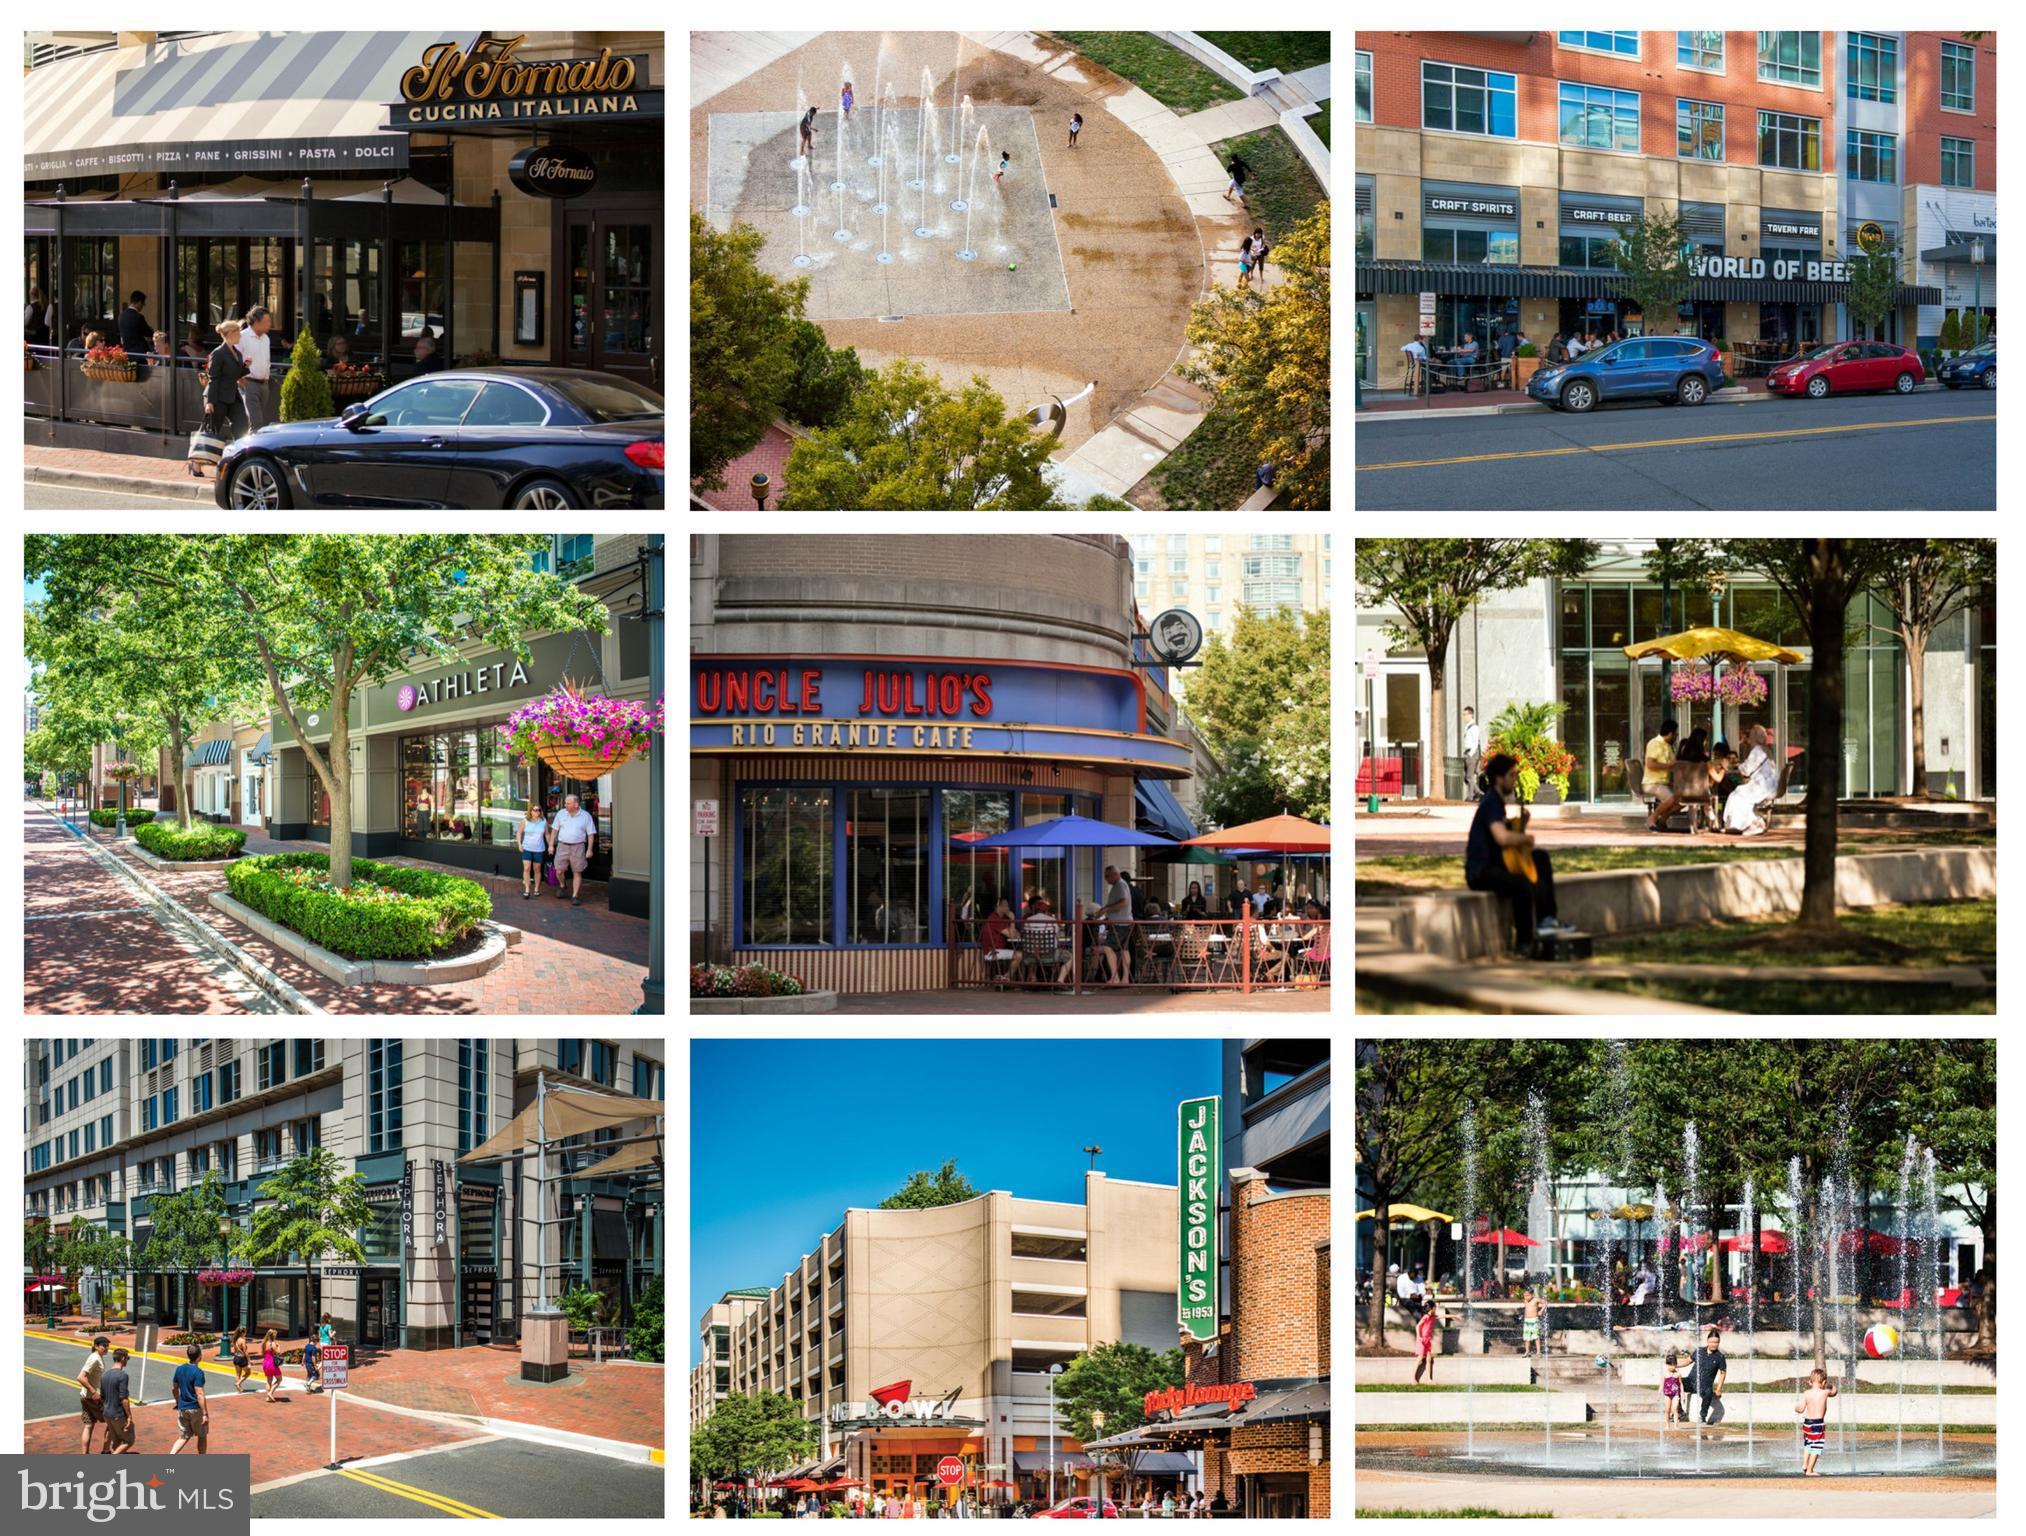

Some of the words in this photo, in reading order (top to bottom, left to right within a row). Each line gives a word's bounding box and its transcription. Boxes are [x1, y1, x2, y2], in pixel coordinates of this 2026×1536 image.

[400, 41, 468, 101] Il
[464, 33, 636, 100] Fornaio
[408, 103, 502, 122] CUCINA
[513, 95, 639, 117] ITALIANA
[40, 160, 66, 170] GRIGLIA
[75, 157, 98, 167] CAFFE
[108, 153, 144, 164] BISCOTTI
[156, 151, 181, 161] PIZZA
[195, 151, 220, 161] PANE
[234, 149, 282, 160] GRISSINI
[299, 149, 336, 159] PASTA
[355, 146, 394, 158] DOLCI
[528, 157, 547, 179] Il
[546, 158, 595, 181] Fornaio
[1432, 199, 1468, 212] CRAFT
[1472, 202, 1513, 214] SPIRITS
[1573, 210, 1604, 221] CRAFT
[1607, 212, 1632, 223] BEER
[1767, 223, 1798, 234] TAVERN
[1799, 225, 1819, 236] FARE
[1687, 255, 1766, 280] WORLD
[1773, 258, 1801, 281] OF
[416, 660, 528, 706] ATHLETA
[696, 669, 823, 714] UNCLE
[858, 670, 994, 717] JULIO'S
[731, 723, 775, 746] RIO
[793, 723, 897, 747] GRANDE
[913, 725, 974, 749] CAFE
[402, 1163, 413, 1246] SEPHORA
[435, 1161, 446, 1245] SEPHORA
[1184, 1105, 1208, 1303] JACKSON'S
[323, 1268, 361, 1277] SEPHORA
[465, 1265, 497, 1274] SEPHORA
[1192, 1306, 1213, 1319] 1953
[324, 1348, 346, 1360] STOP
[1184, 1382, 1256, 1412] Lounge
[940, 1464, 962, 1477] STOP
